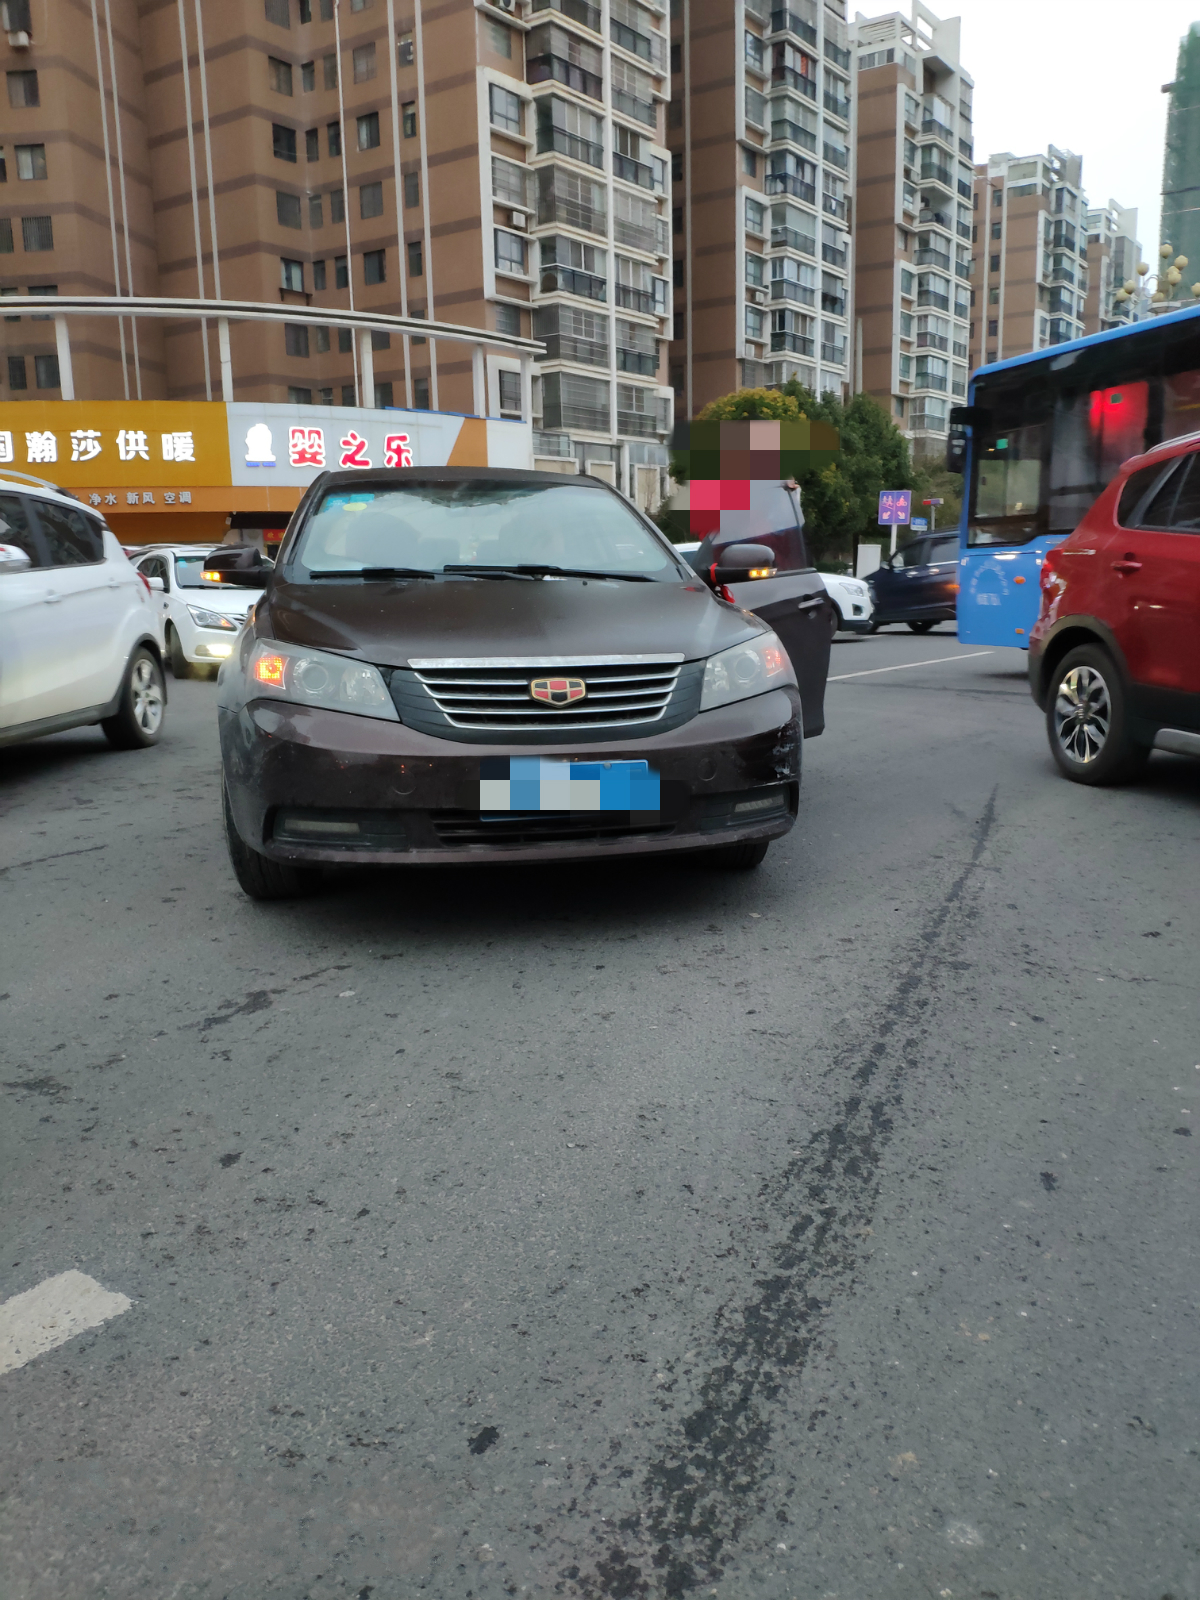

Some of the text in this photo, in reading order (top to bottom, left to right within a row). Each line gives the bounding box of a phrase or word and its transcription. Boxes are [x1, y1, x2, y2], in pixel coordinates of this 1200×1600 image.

[289, 426, 412, 468] 婴之乐
[88, 491, 192, 506] 净水 新风 空调
